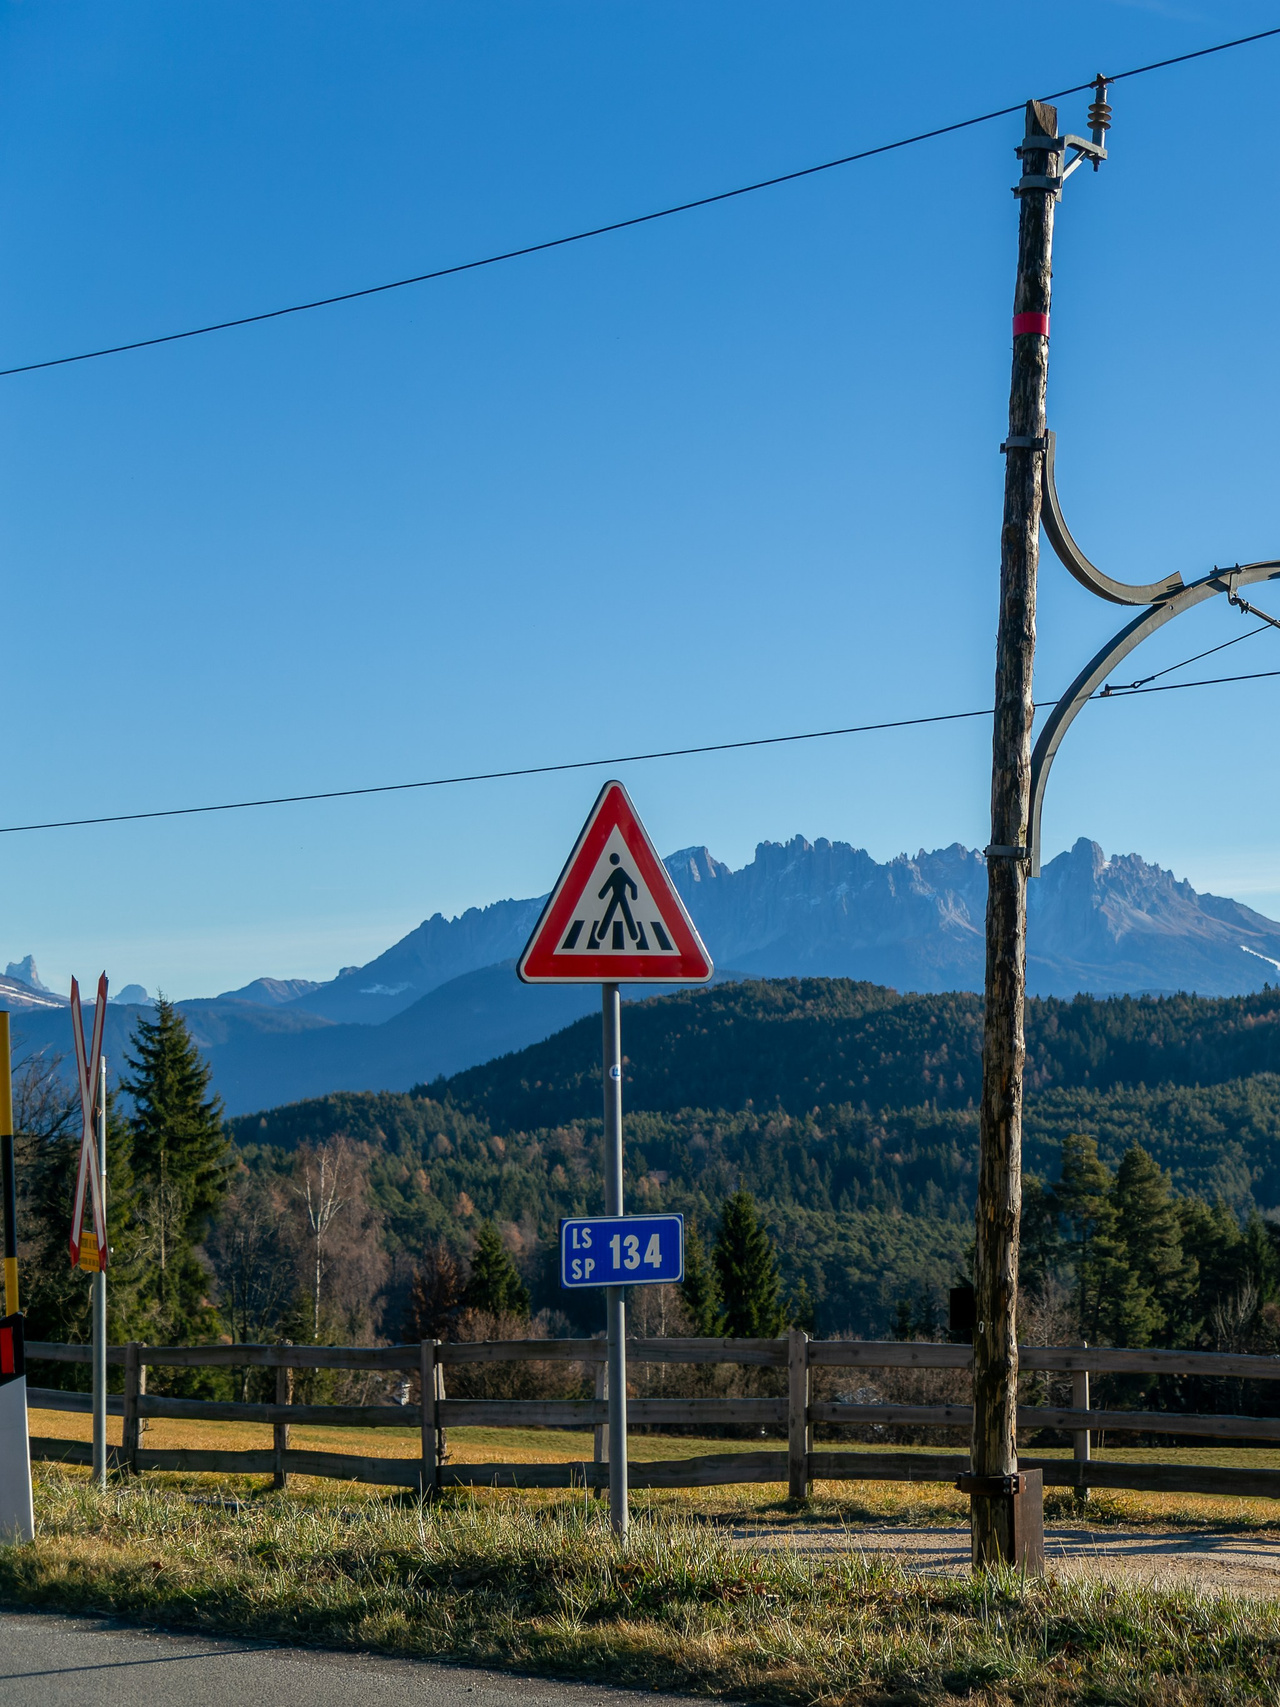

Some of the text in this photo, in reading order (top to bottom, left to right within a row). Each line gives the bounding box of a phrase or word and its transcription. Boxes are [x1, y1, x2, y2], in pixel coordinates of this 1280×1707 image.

[572, 1228, 592, 1249] LS
[609, 1234, 662, 1270] 134
[571, 1258, 595, 1280] SP
